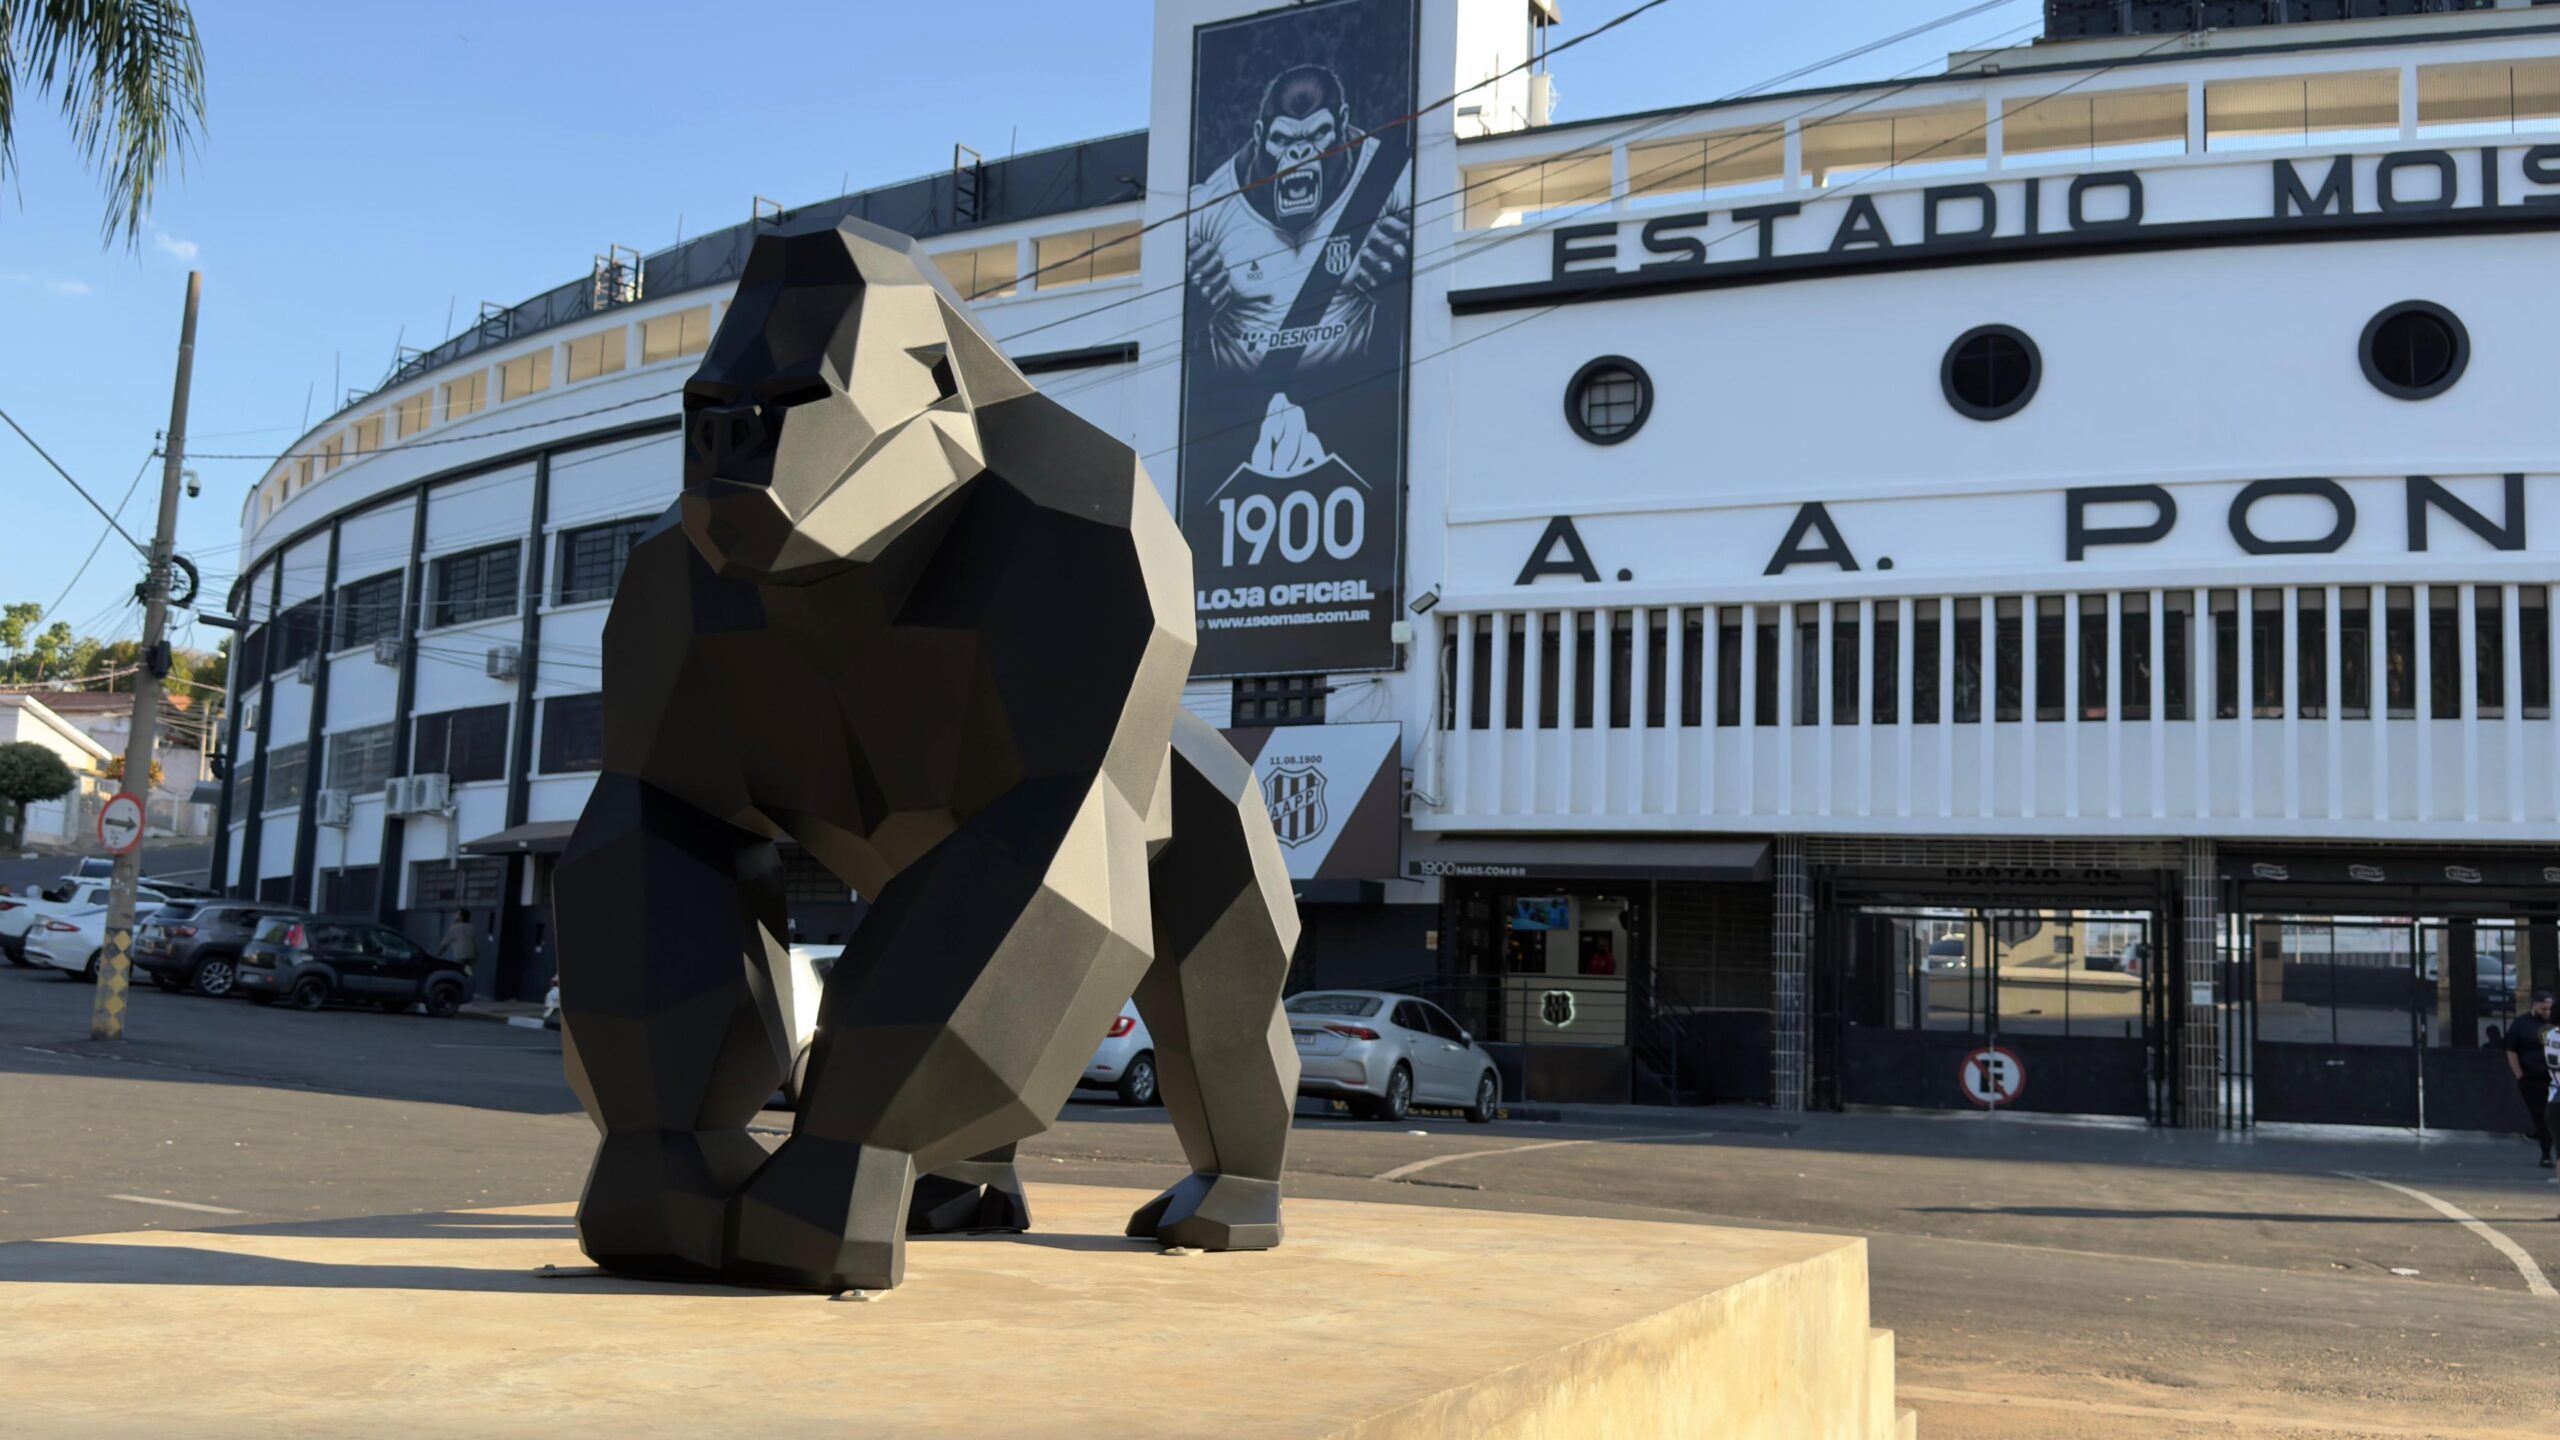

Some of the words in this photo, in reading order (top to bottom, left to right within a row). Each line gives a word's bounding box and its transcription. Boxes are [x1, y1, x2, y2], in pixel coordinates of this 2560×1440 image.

[1552, 169, 2143, 281] ESTADIO
[1268, 323, 1346, 348] DESKTOP
[1219, 486, 1365, 568] 1900
[1513, 514, 1633, 585] A.
[1762, 501, 1894, 576] A.
[2065, 472, 2526, 562] PON
